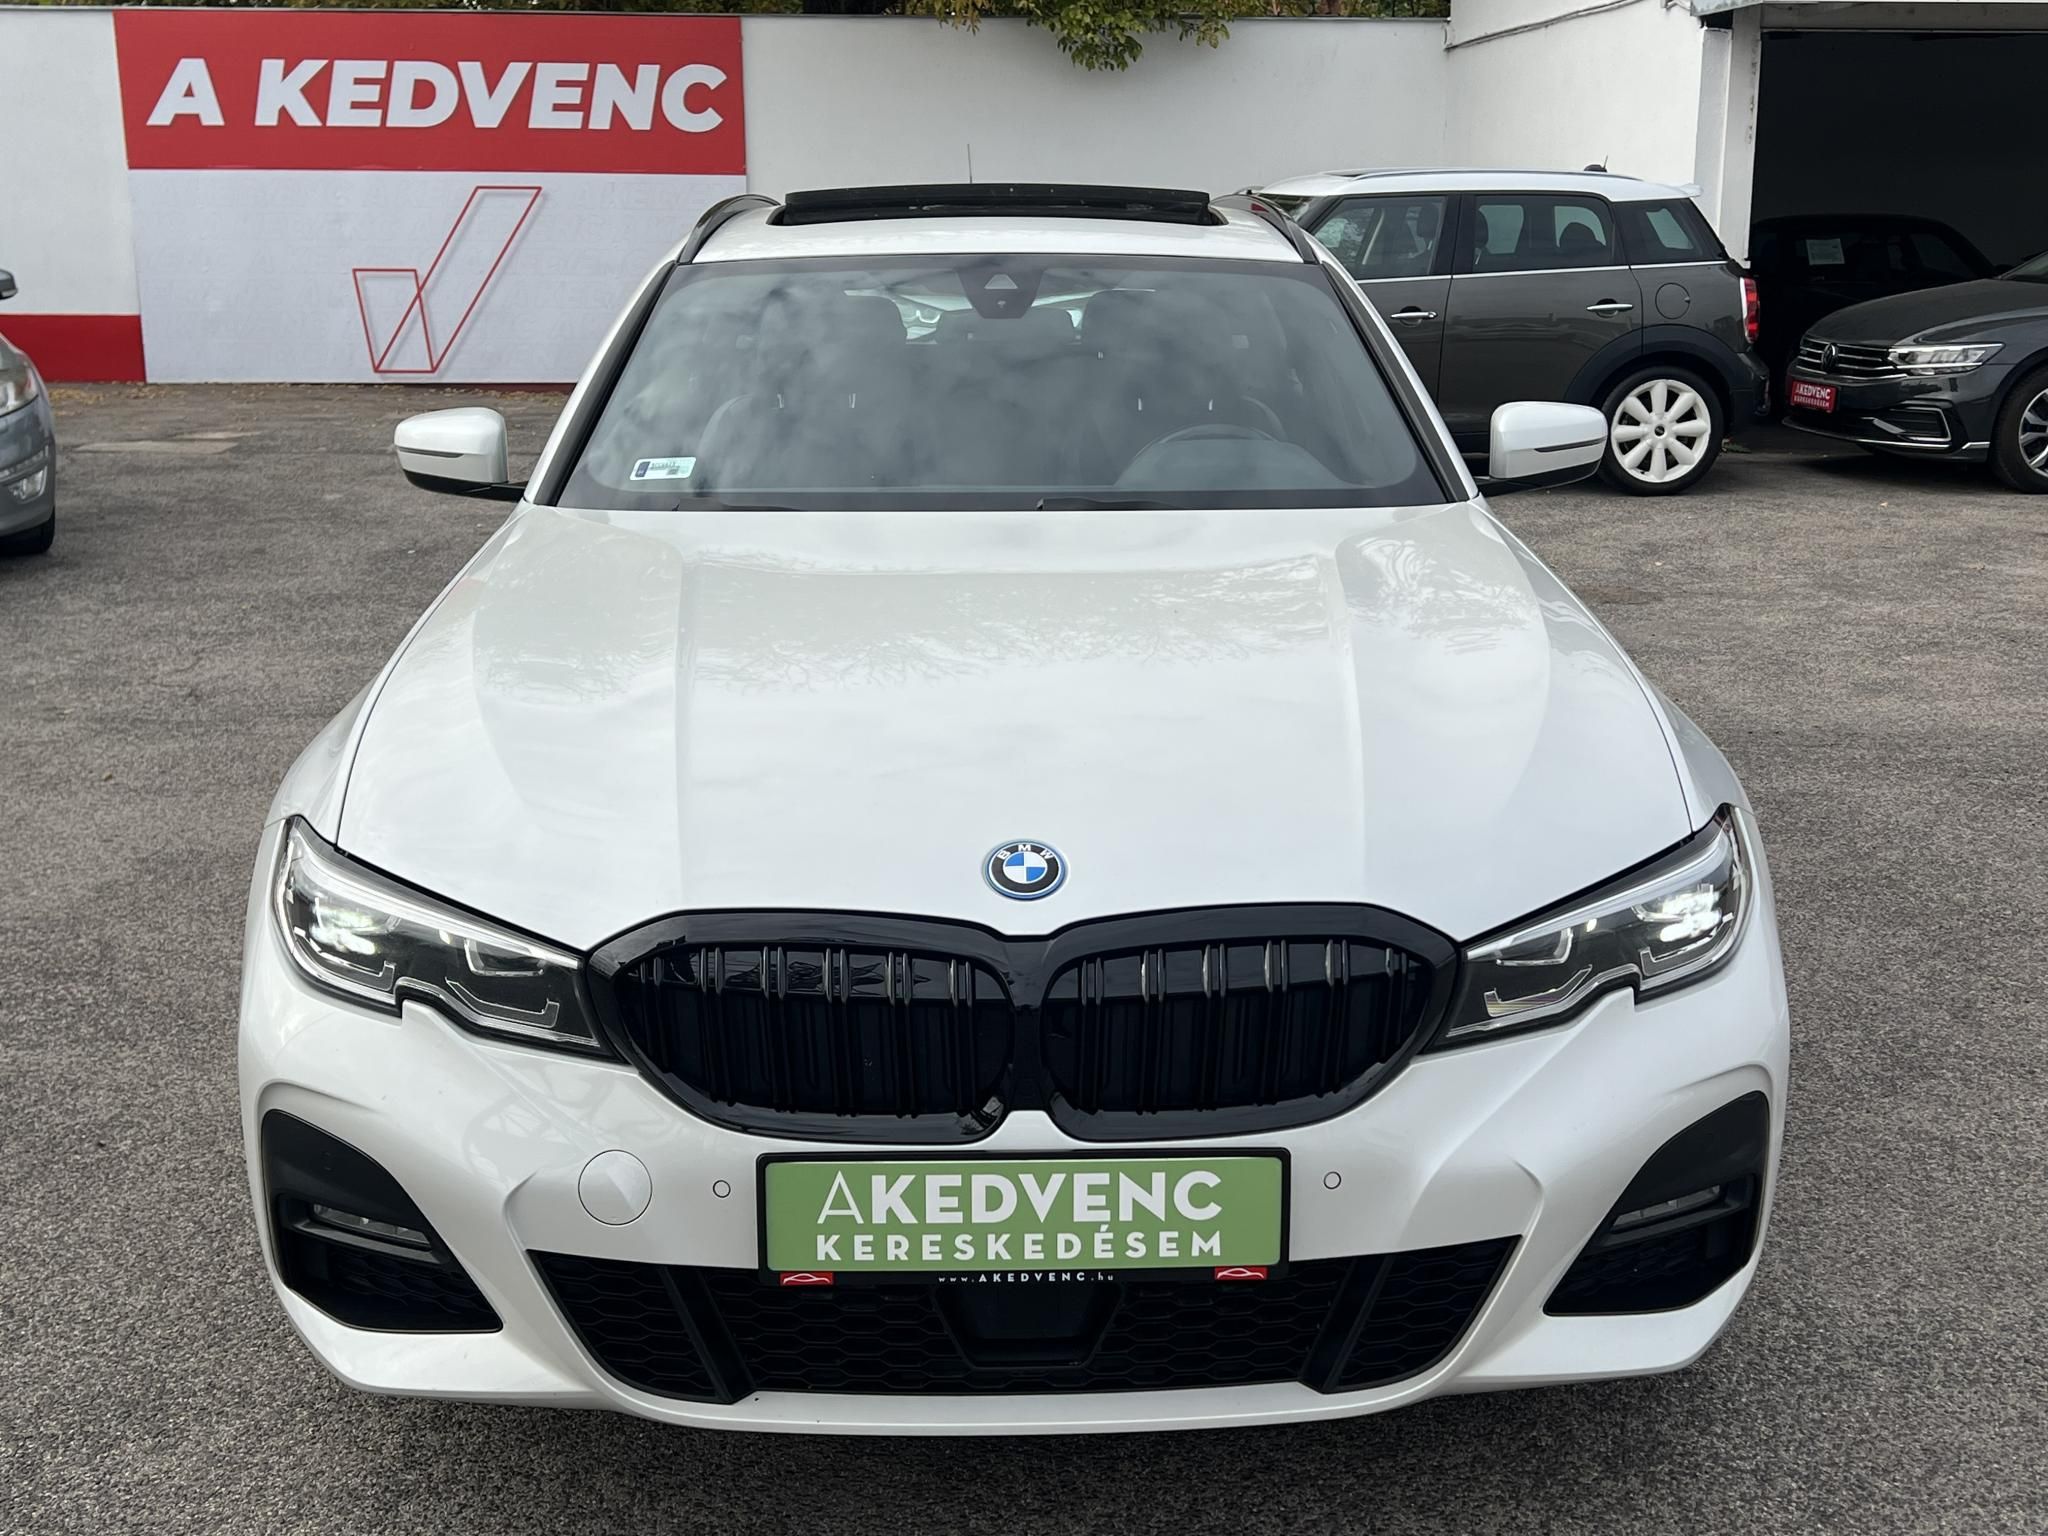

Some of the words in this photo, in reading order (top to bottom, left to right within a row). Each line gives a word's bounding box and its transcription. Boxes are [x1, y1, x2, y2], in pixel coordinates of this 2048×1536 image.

[146, 58, 225, 127] A
[254, 58, 727, 133] KEDVENC
[997, 844, 1054, 860] BMW
[817, 1225, 1222, 1261] KERESKEDÉSEM
[938, 1272, 1114, 1283] www.AKEDVENC.hu
